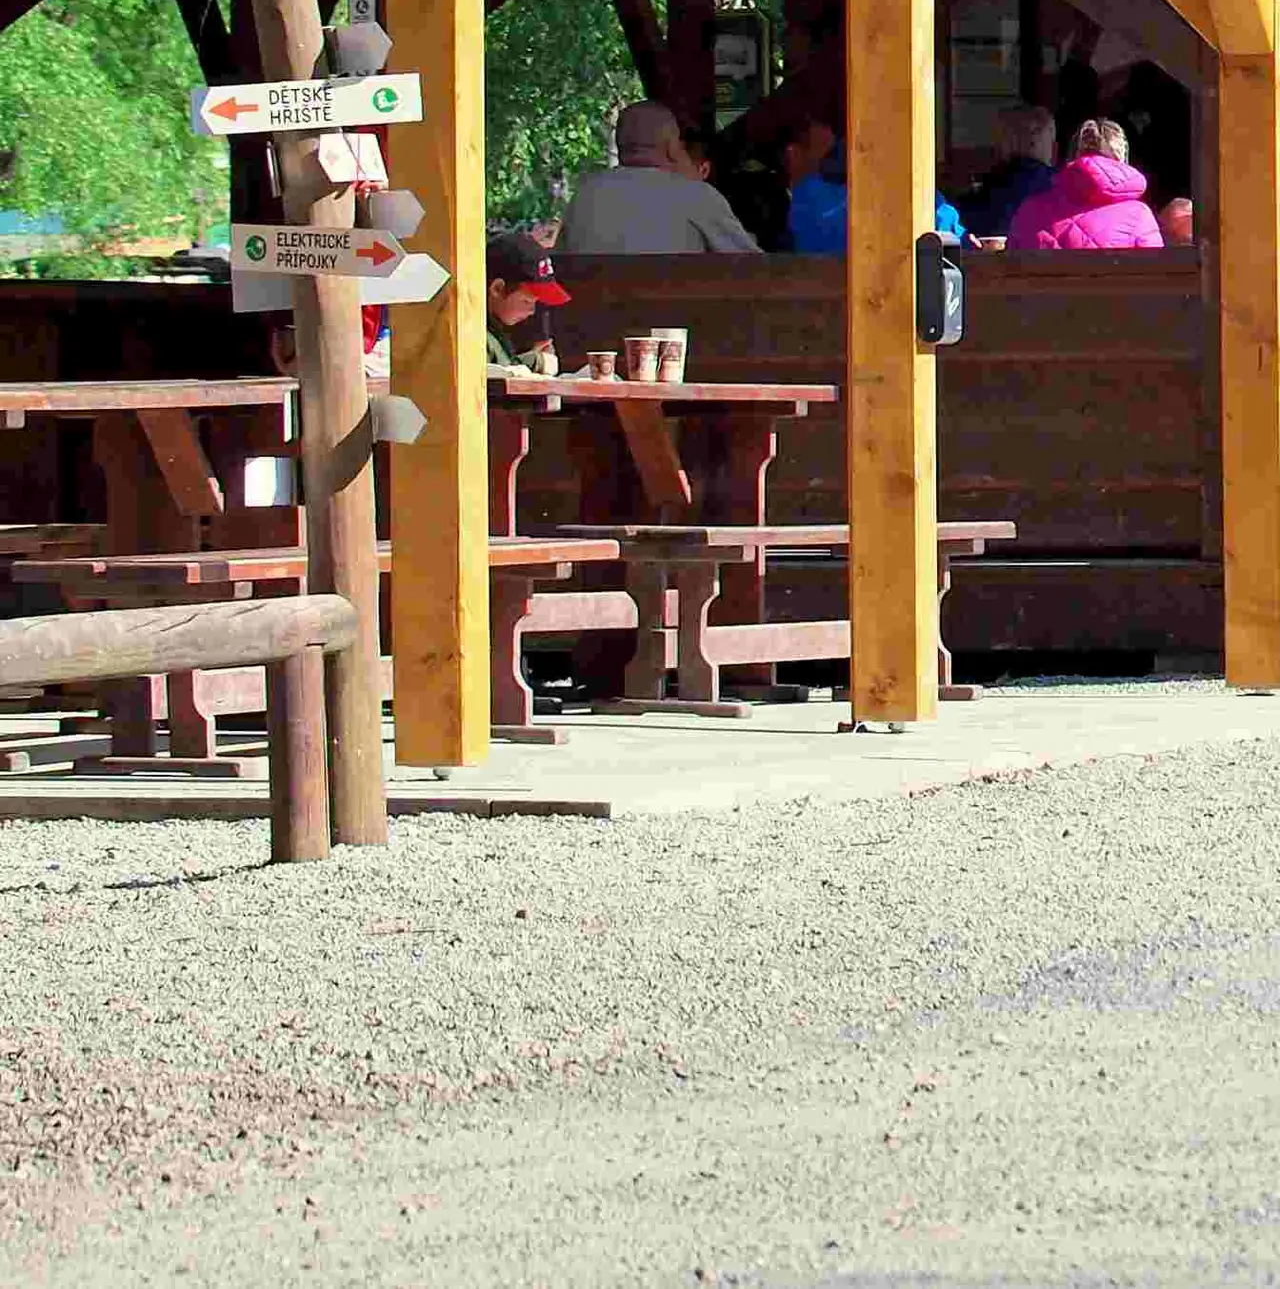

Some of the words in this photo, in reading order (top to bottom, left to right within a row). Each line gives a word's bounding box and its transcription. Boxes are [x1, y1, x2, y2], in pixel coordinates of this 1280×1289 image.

[268, 82, 334, 106] DĚTSKÉ
[276, 231, 351, 250] ELEKTRICKÉ
[276, 250, 338, 269] PŘÍPOJKY
